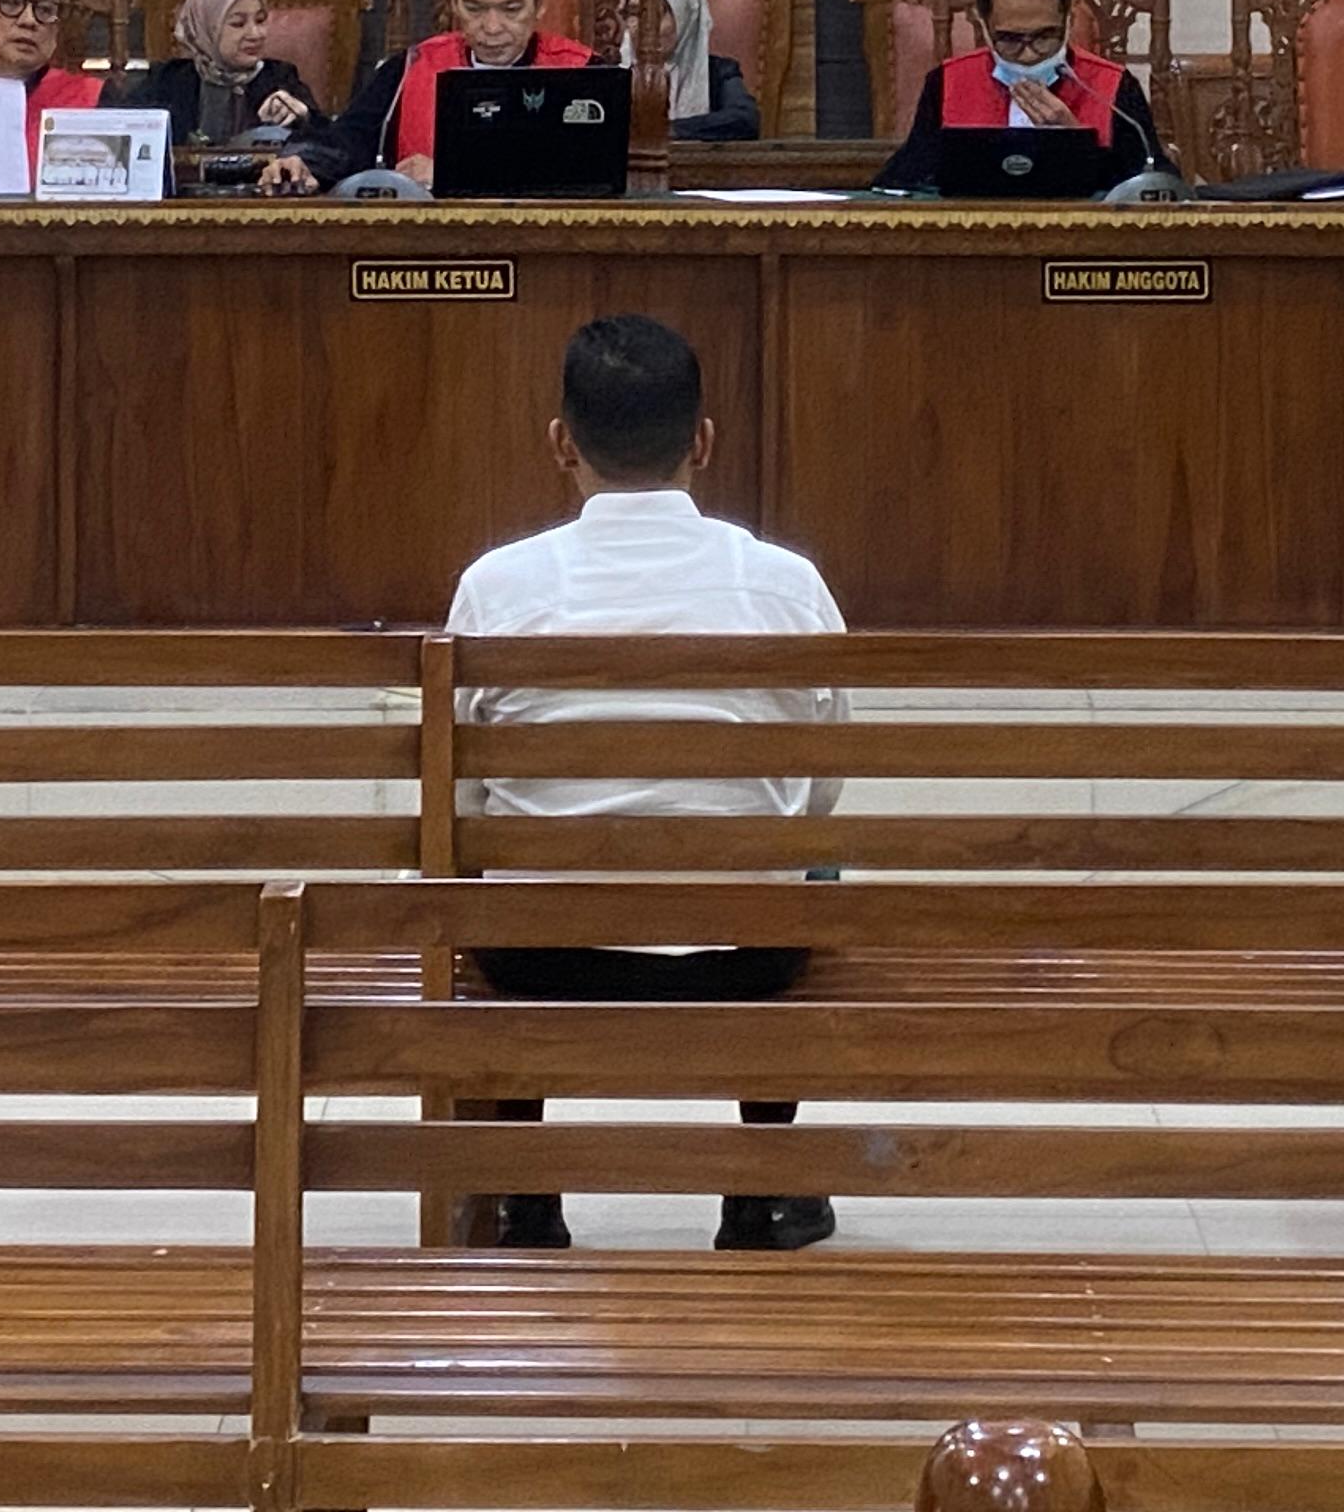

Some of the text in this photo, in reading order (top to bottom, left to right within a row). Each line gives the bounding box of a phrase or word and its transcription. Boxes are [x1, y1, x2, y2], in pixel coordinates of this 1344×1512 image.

[362, 270, 504, 290] HAKIM KETUA
[1053, 271, 1200, 290] HAKIM ANGGOTA
